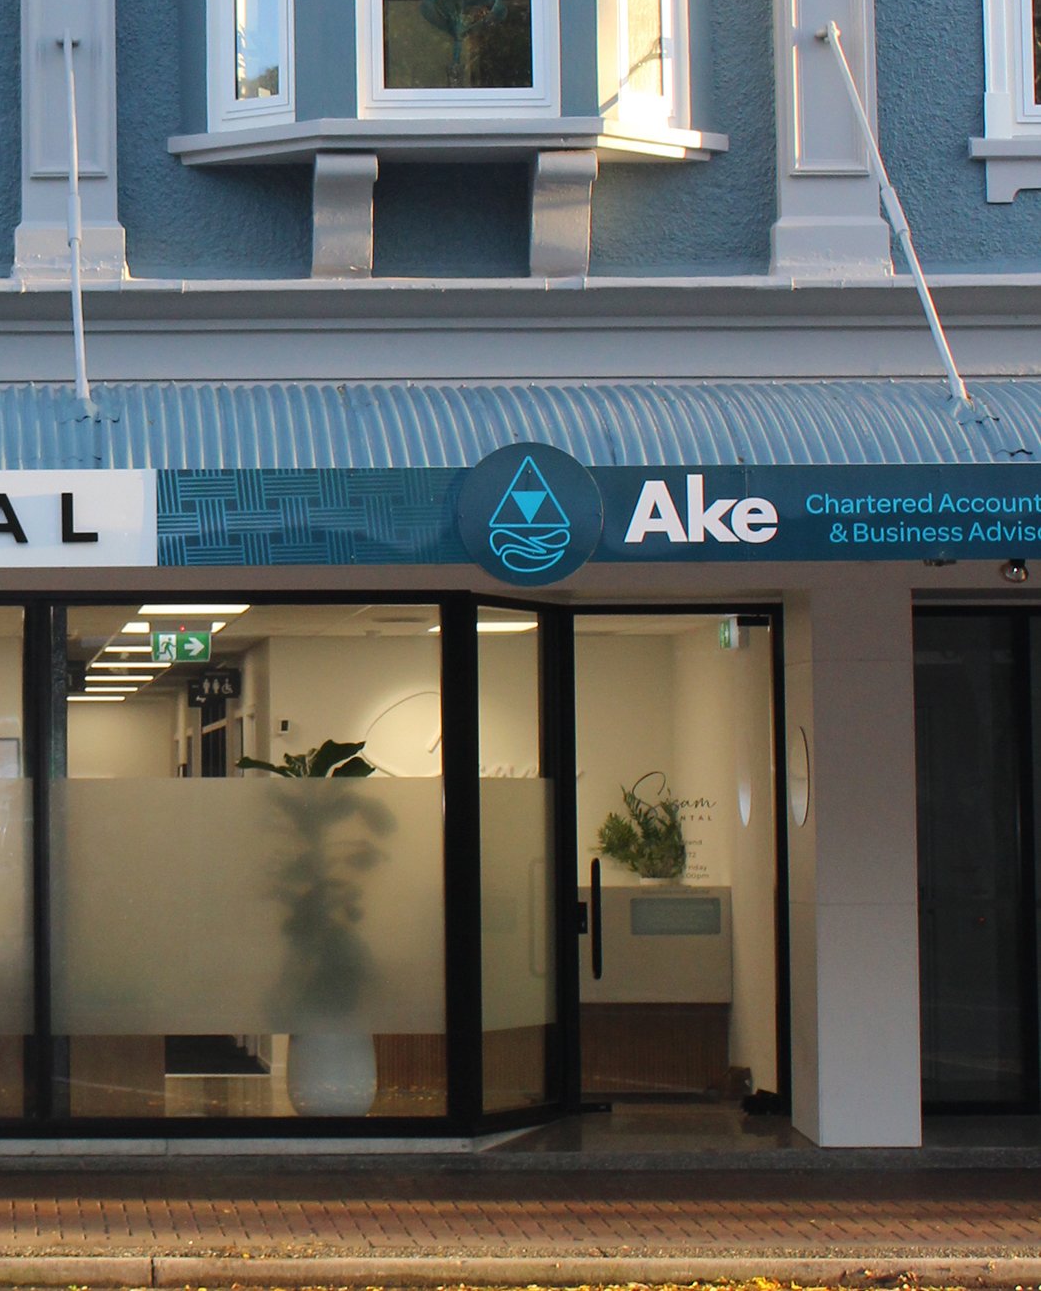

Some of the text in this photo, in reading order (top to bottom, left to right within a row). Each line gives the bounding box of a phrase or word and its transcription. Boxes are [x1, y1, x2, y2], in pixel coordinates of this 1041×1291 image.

[624, 474, 778, 544] Ake
[805, 493, 1041, 515] Chartered Account
[829, 521, 1041, 543] & Business Advis
